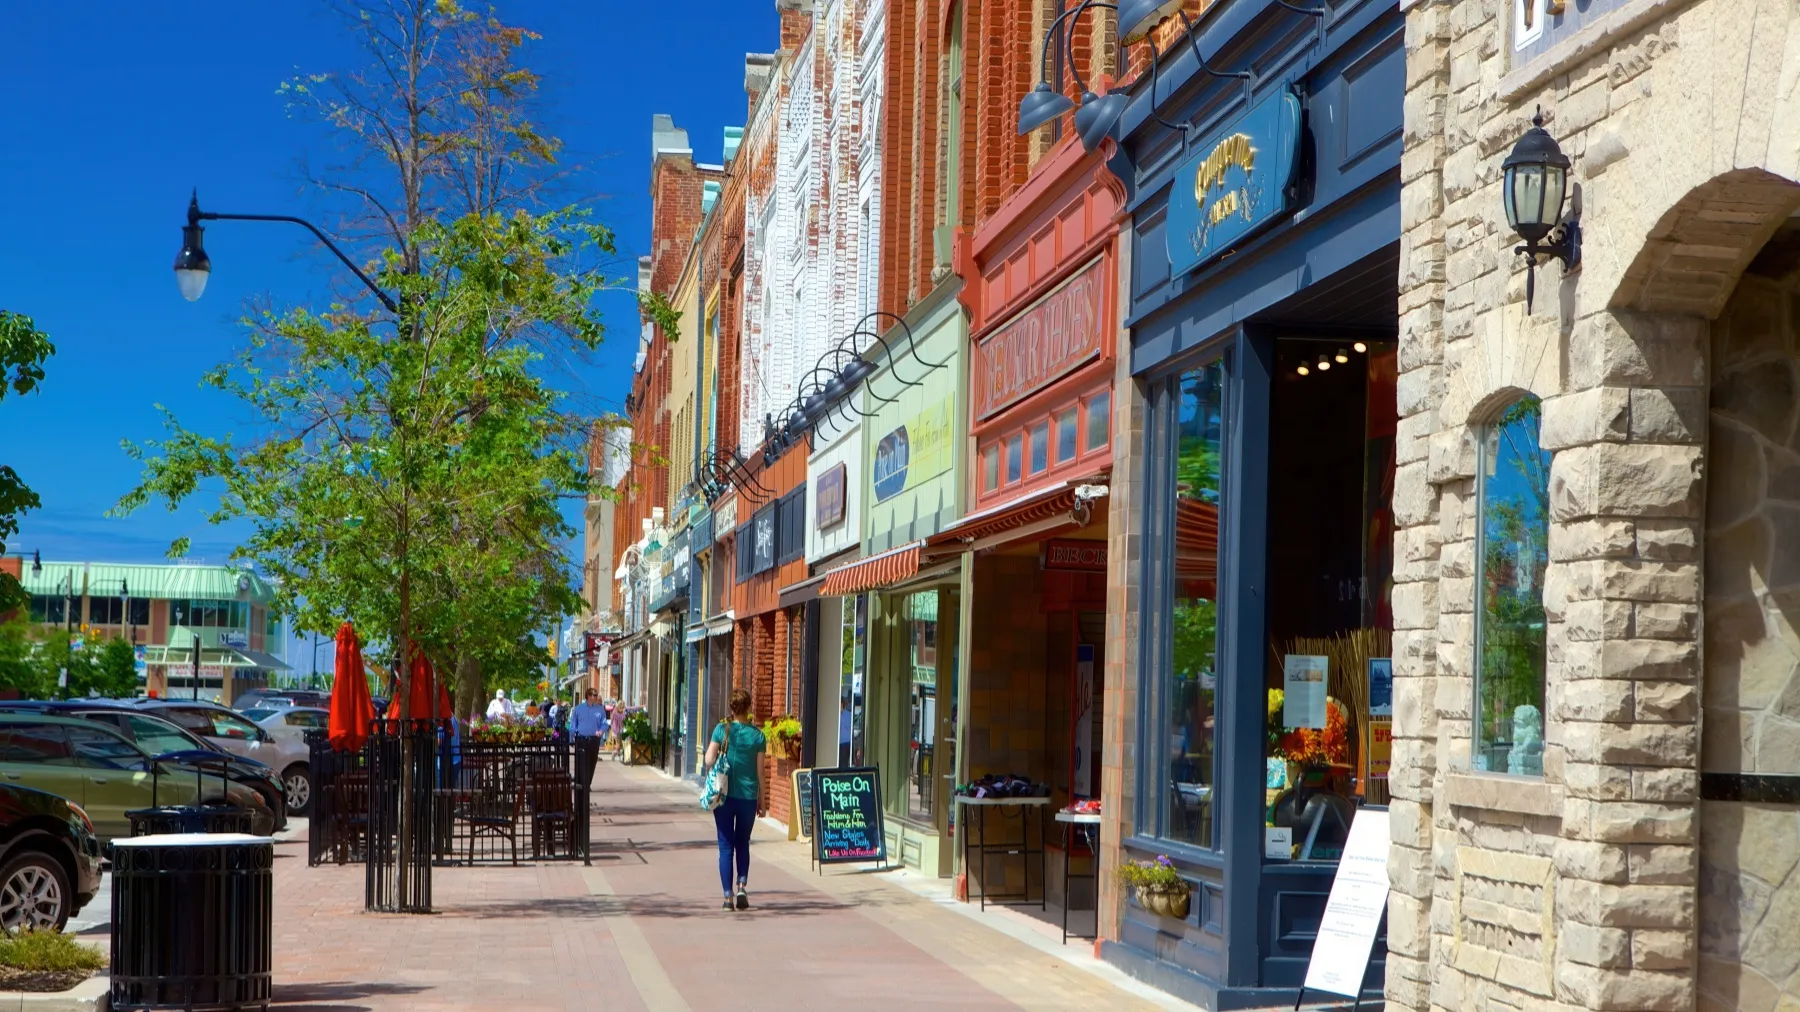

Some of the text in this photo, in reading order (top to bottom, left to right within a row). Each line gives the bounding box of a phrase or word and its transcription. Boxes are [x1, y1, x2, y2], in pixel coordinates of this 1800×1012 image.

[1042, 279, 1094, 378] SHOES
[823, 776, 870, 794] Poise On
[830, 792, 860, 811] Main
